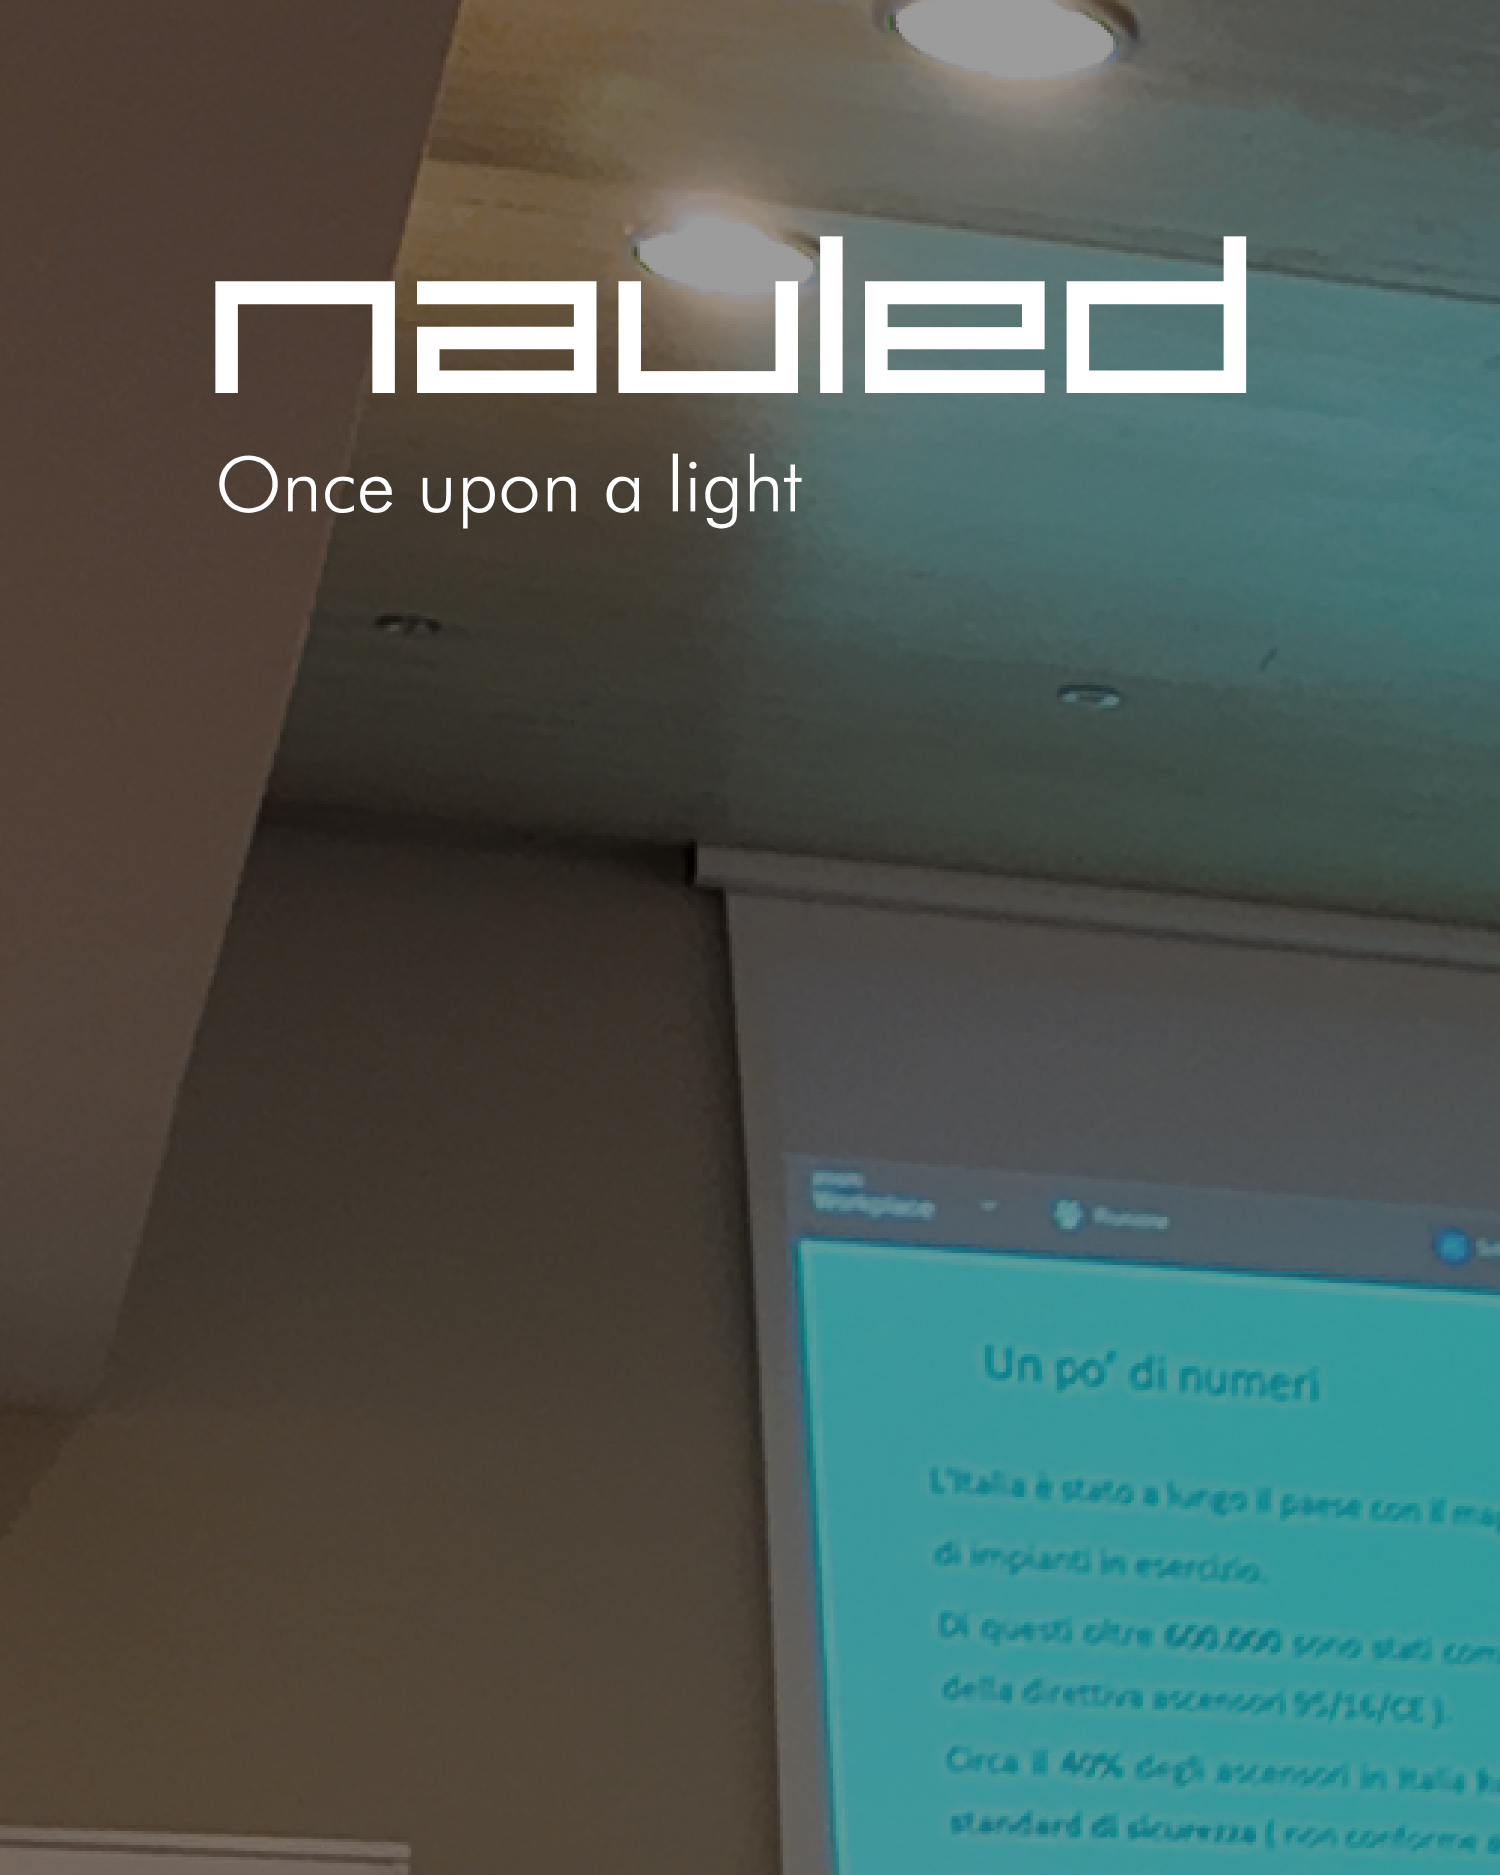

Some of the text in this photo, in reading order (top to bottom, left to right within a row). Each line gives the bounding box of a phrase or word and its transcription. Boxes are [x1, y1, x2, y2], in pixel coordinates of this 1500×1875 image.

[983, 1342, 1043, 1384] Un
[1128, 1353, 1168, 1391] di
[1178, 1365, 1321, 1403] numeri
